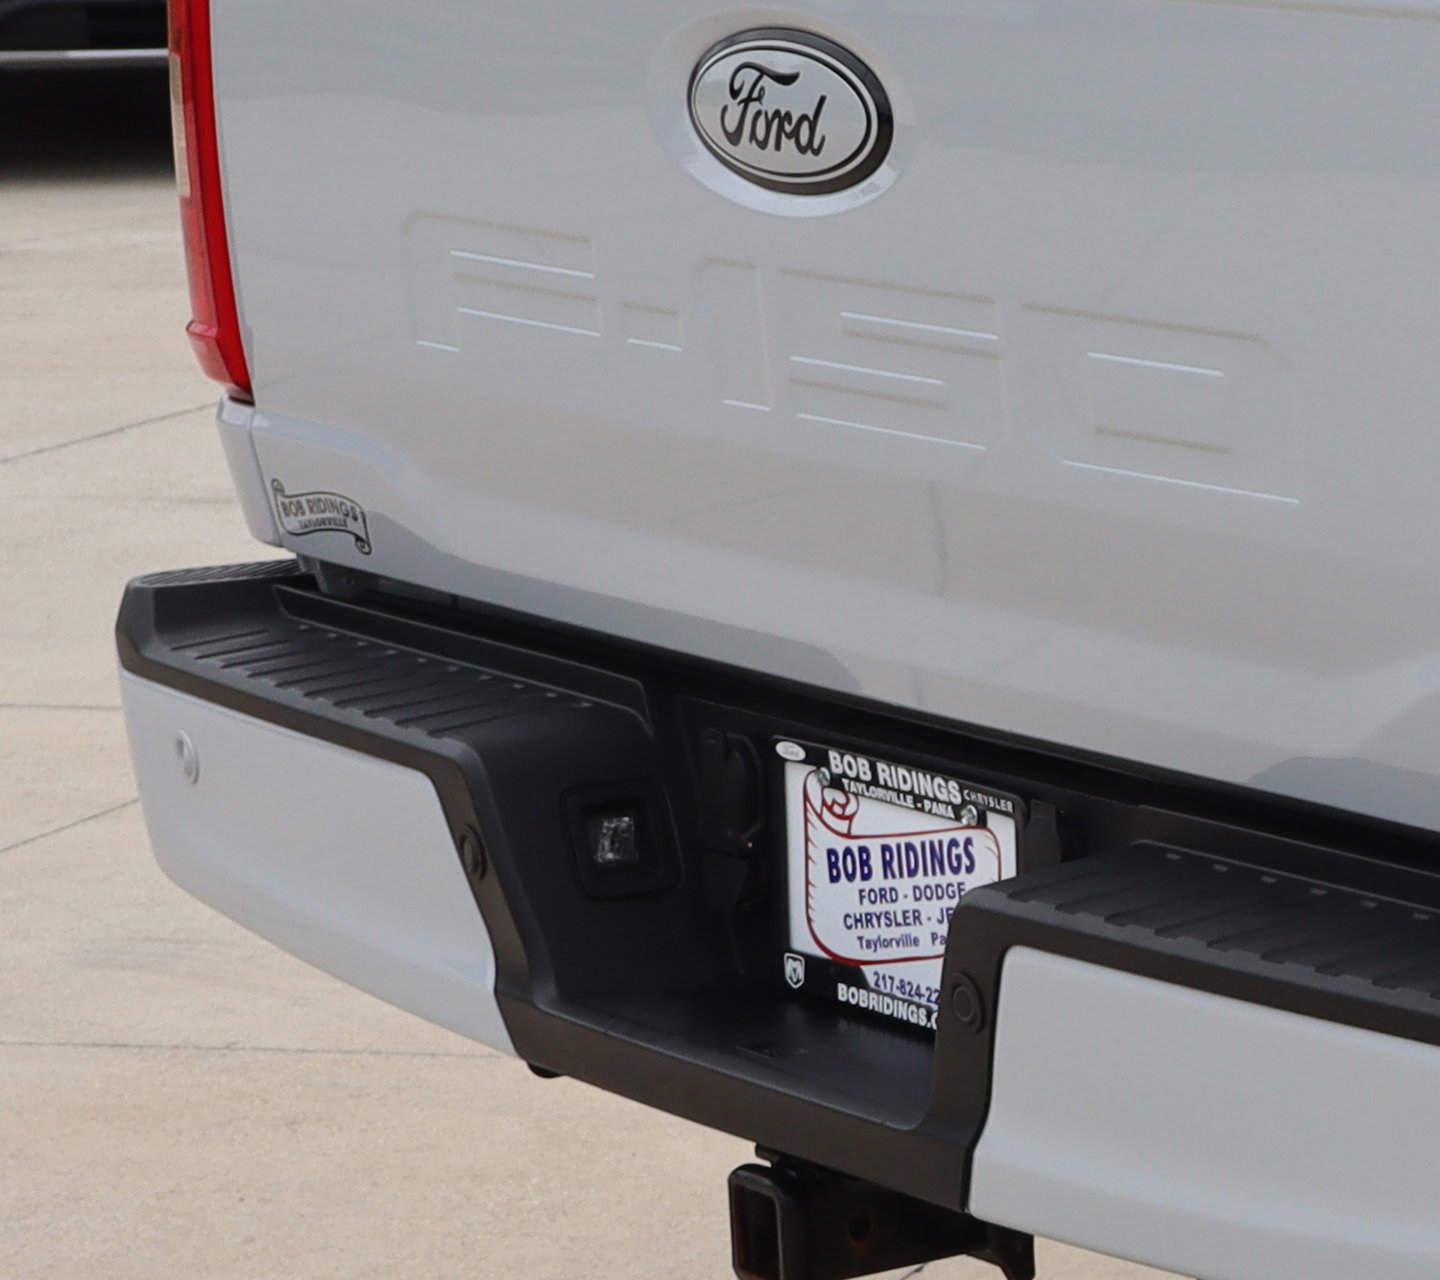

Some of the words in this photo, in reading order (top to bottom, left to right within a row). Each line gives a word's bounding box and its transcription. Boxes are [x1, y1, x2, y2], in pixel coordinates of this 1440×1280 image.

[720, 60, 828, 158] Ford
[281, 499, 306, 517] BOB
[305, 497, 359, 522] RIDINGS
[828, 750, 872, 782] BOB
[876, 761, 963, 805] RIDINGS
[963, 788, 1014, 813] CHRYSLER
[841, 777, 915, 809] TAYLORVILLE
[924, 799, 956, 820] PANA
[826, 843, 873, 884] BOB
[880, 836, 977, 880] RIDINGS
[858, 887, 899, 906] FORD
[912, 882, 966, 902] DODGE
[843, 909, 923, 930] CHRYSLER
[857, 934, 920, 952] Taylorville
